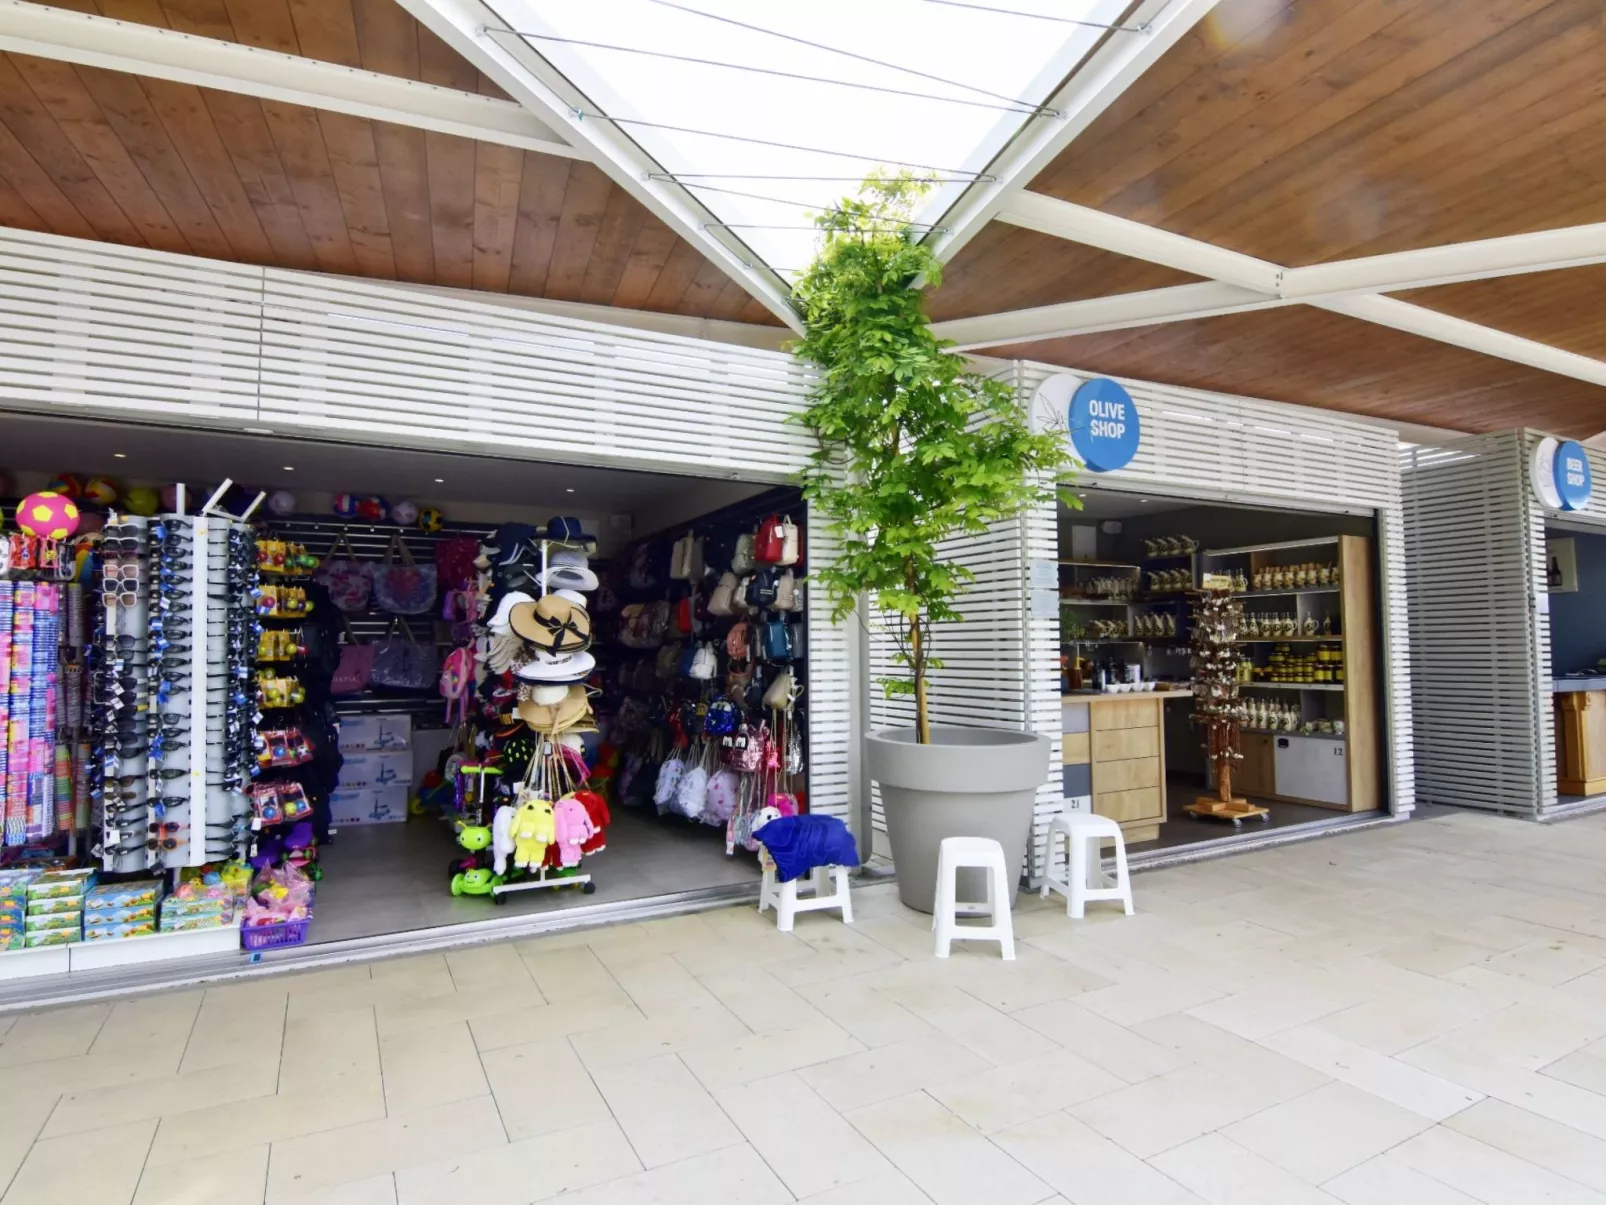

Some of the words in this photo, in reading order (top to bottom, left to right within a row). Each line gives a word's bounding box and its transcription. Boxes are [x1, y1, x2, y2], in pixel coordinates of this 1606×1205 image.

[1089, 400, 1125, 420] OLIVE
[1090, 419, 1125, 439] SHOP
[1566, 457, 1583, 473] BEER
[1567, 471, 1585, 487] SHOP
[1334, 747, 1344, 756] 12
[1071, 799, 1080, 809] 21
